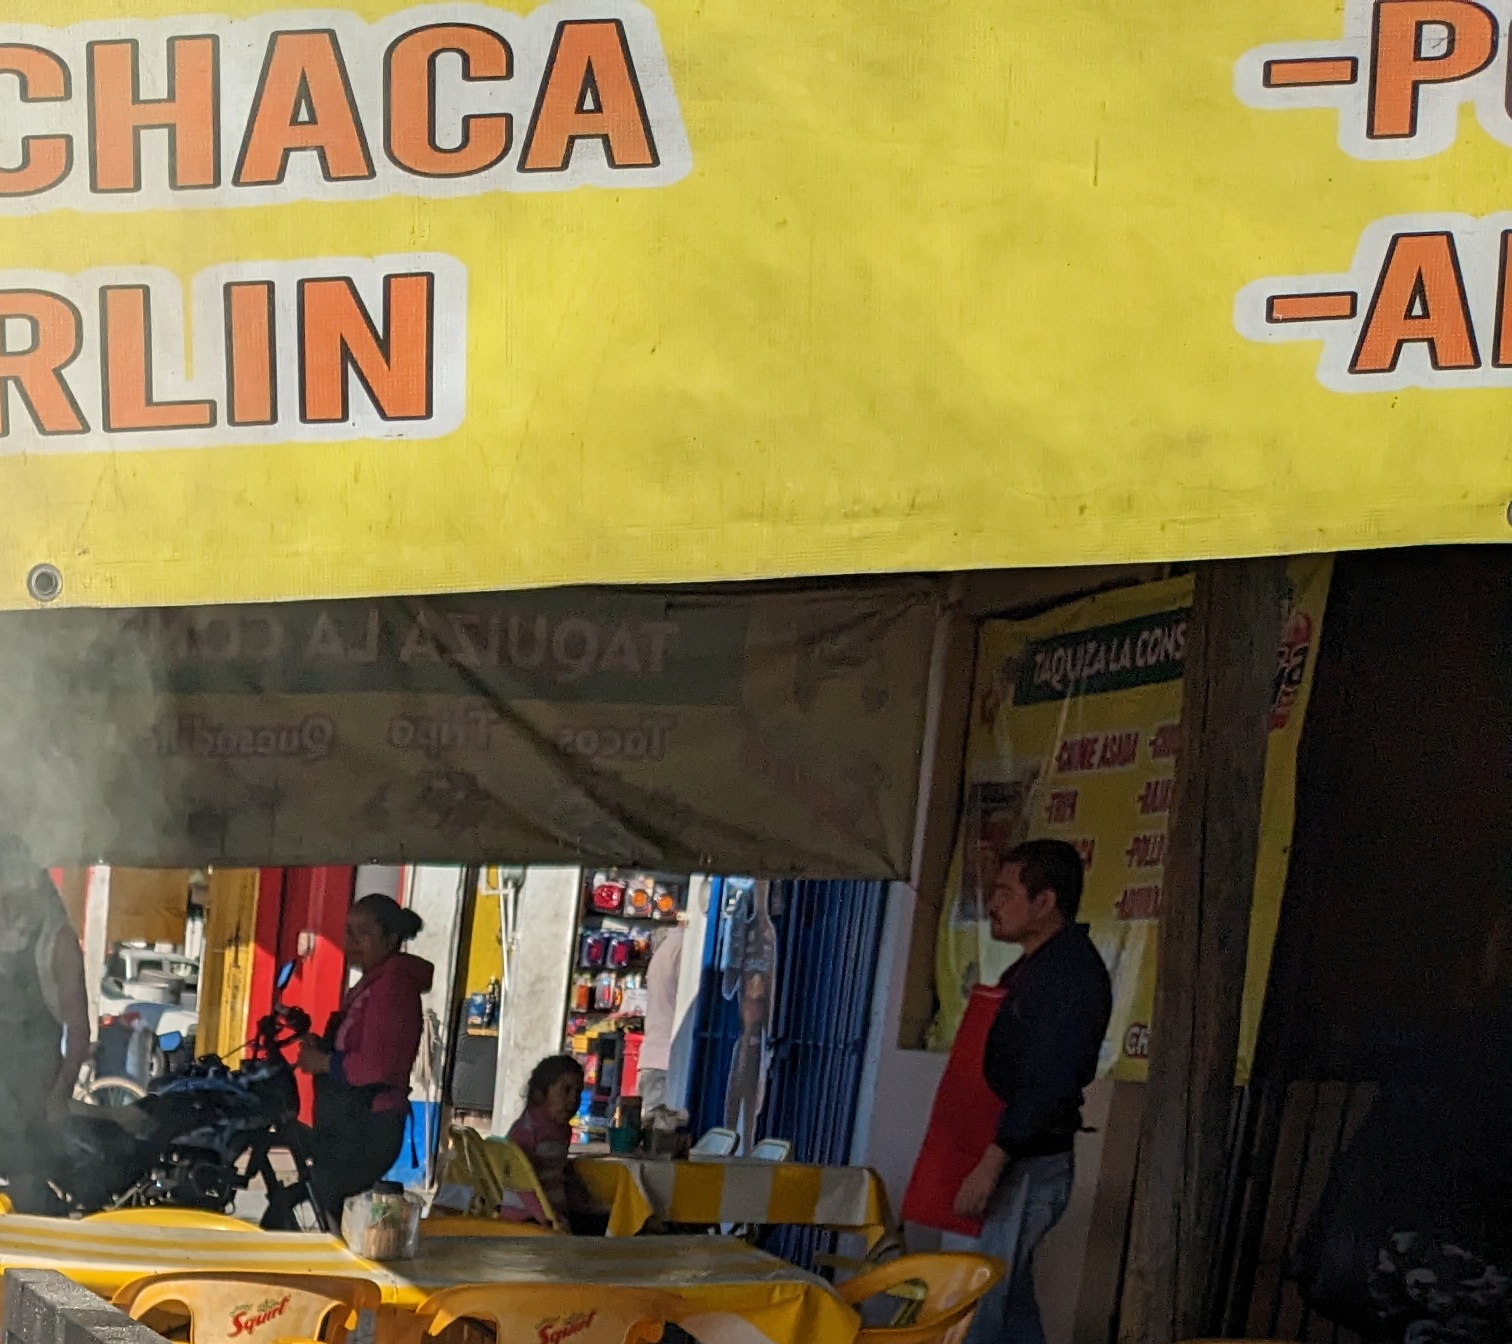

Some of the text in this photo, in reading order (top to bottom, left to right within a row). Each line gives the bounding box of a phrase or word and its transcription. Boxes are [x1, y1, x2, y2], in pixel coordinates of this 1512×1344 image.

[1263, 0, 1512, 139] -P
[1266, 230, 1512, 374] -A
[227, 1293, 292, 1338] Squirt
